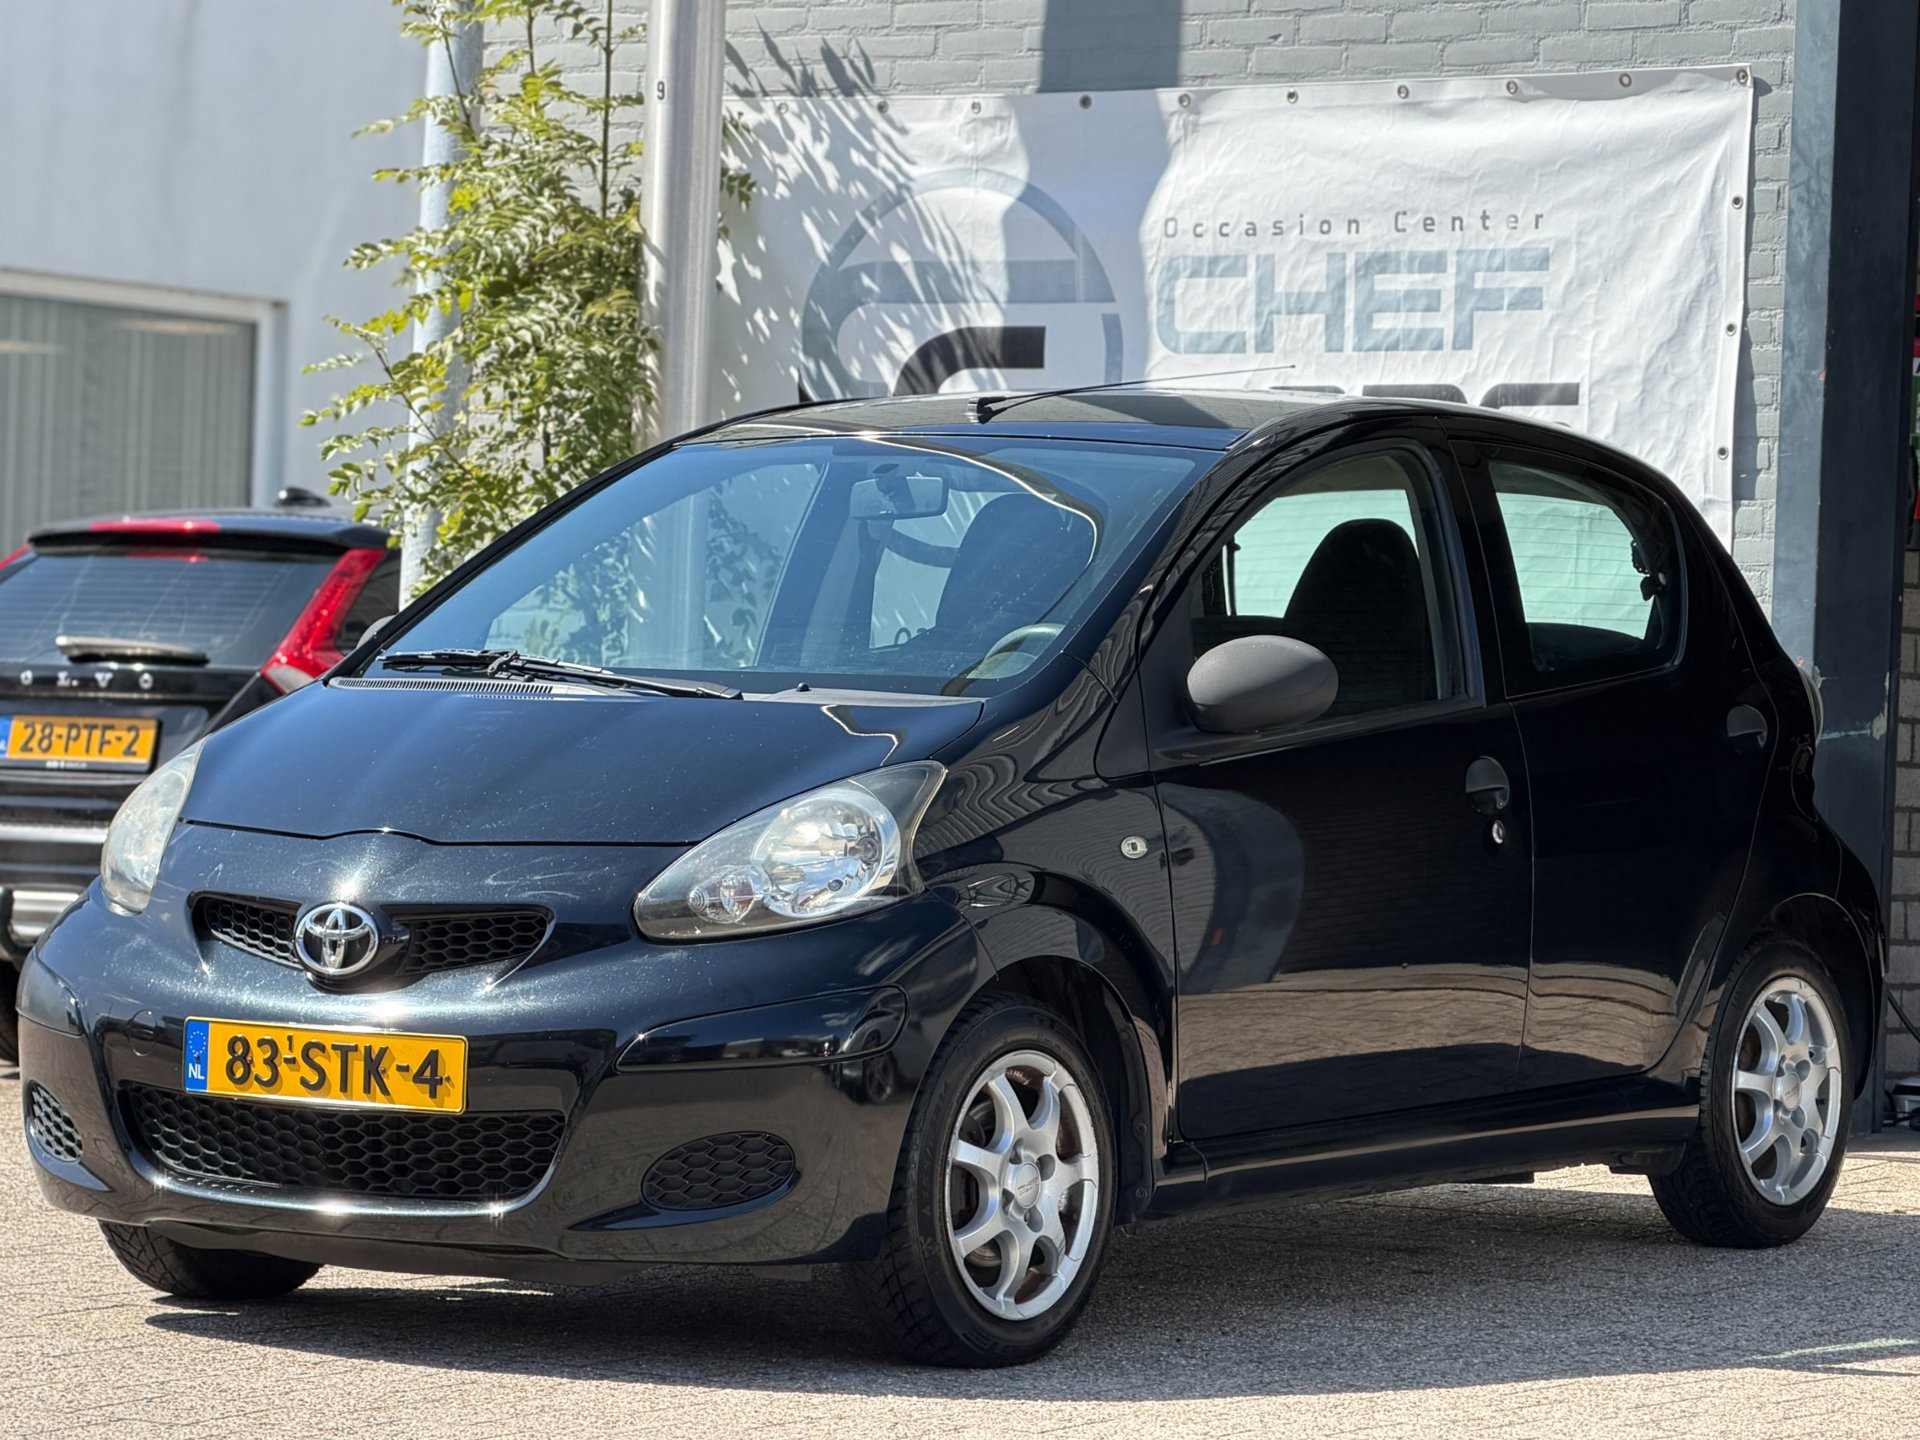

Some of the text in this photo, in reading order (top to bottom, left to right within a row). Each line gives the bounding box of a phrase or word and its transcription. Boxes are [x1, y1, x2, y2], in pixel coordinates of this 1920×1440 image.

[656, 80, 666, 100] 9
[1163, 209, 1544, 239] Occasion Center
[1156, 248, 1550, 355] CHEF
[20, 721, 141, 757] 28-PTF-2
[187, 1062, 206, 1081] NL
[225, 1033, 444, 1099] 83-STK-4
